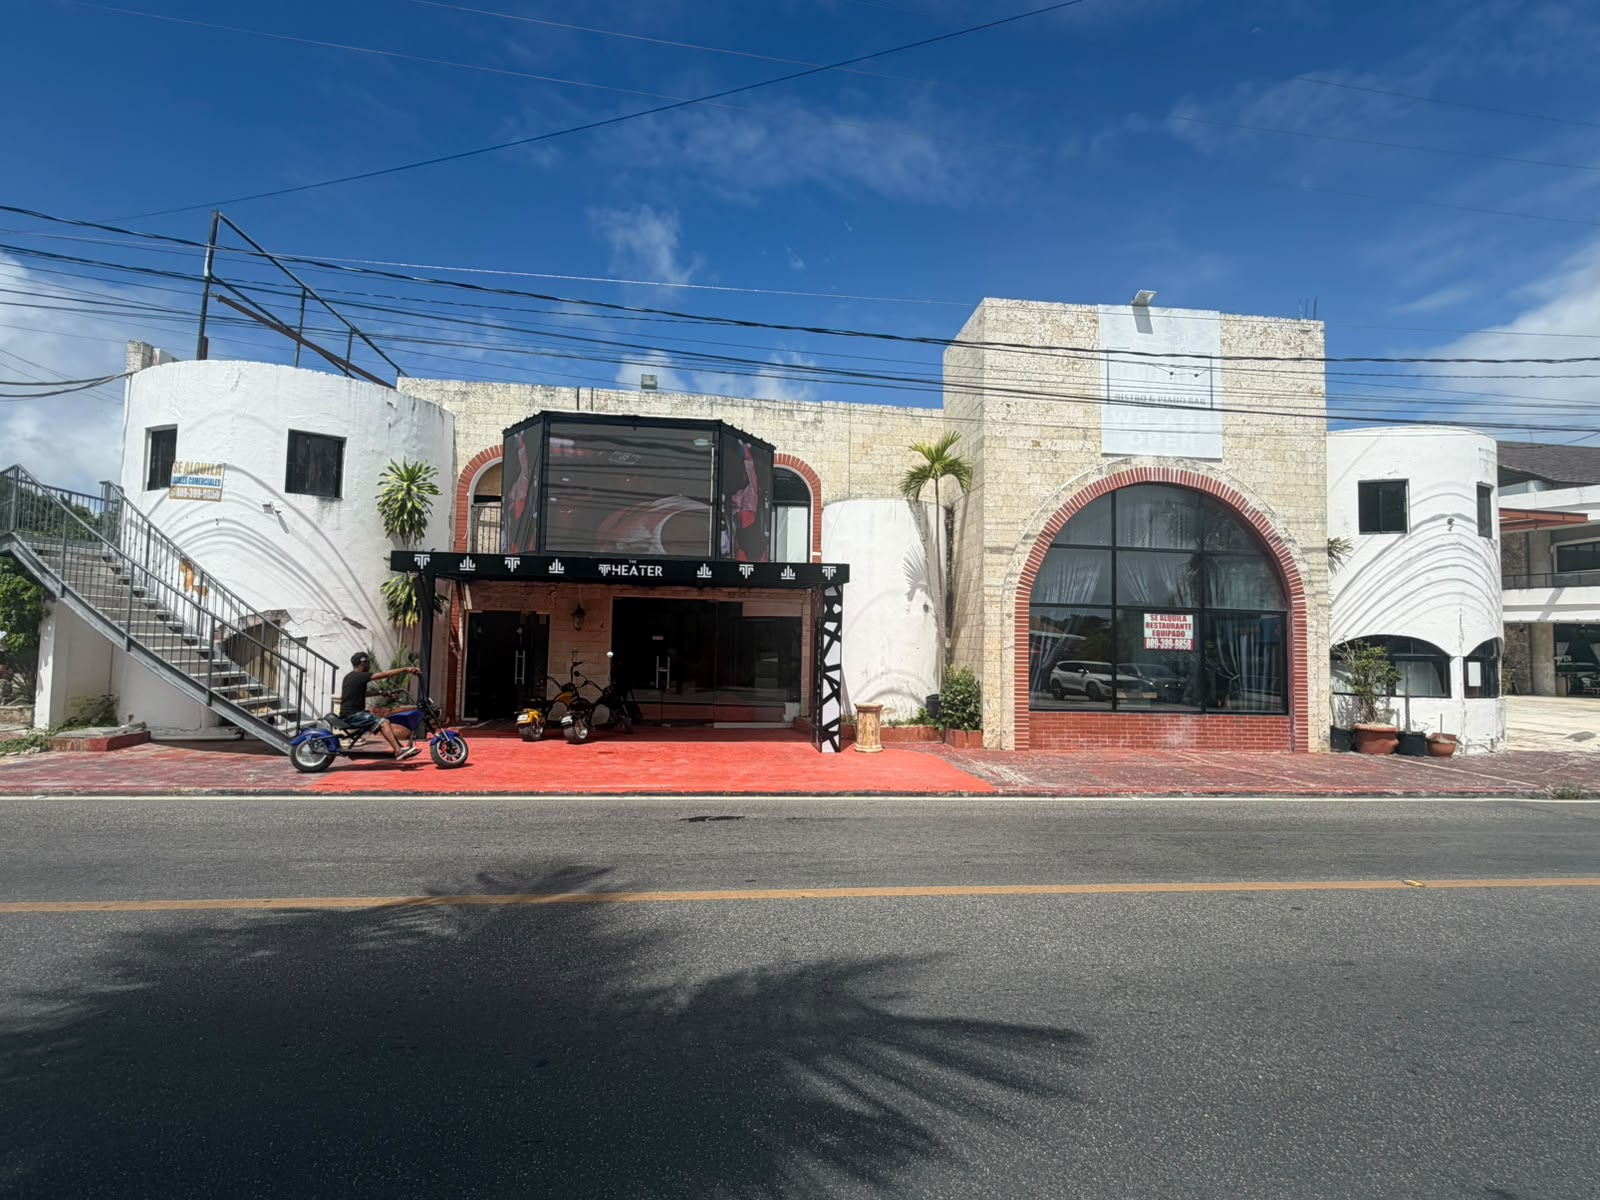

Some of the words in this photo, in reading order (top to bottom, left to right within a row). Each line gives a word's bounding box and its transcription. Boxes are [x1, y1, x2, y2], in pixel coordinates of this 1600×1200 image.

[172, 461, 183, 474] SE
[184, 461, 222, 476] ALQUILA
[598, 564, 663, 576] THEATER
[1151, 614, 1159, 622] SE
[1160, 614, 1188, 622] ALQUILA
[1145, 622, 1193, 630] RESTAURANTE
